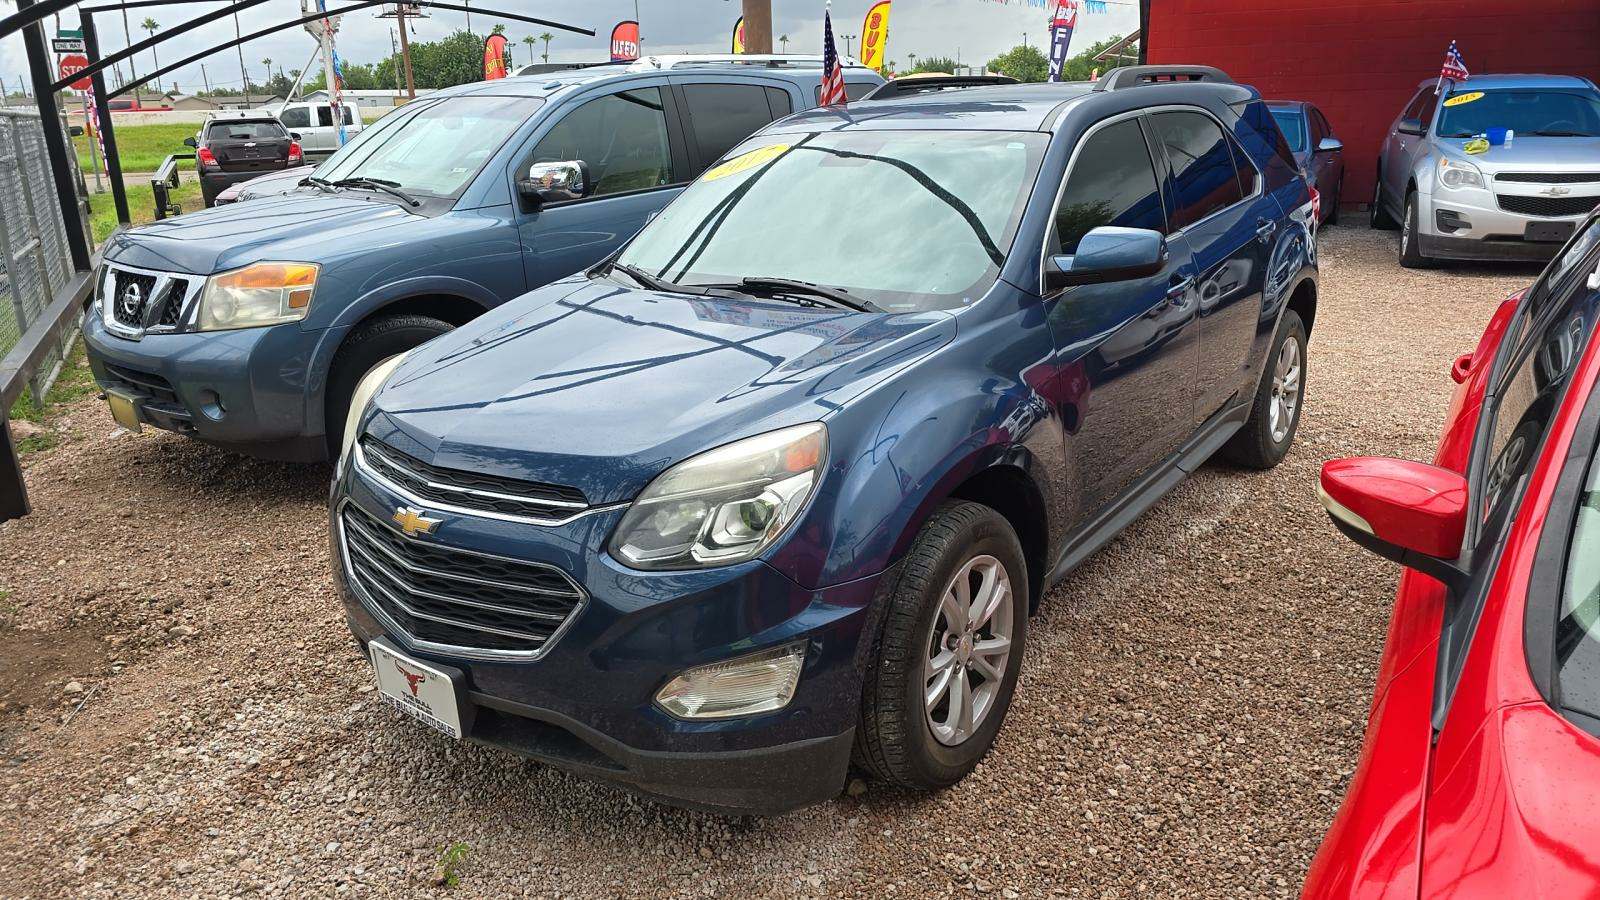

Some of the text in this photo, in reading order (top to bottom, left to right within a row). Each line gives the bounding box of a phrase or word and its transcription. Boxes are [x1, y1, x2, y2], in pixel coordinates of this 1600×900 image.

[613, 39, 637, 57] USED
[865, 13, 881, 65] BUY
[62, 65, 88, 79] ST
[381, 692, 456, 737] THE BULL AUTO SALES
